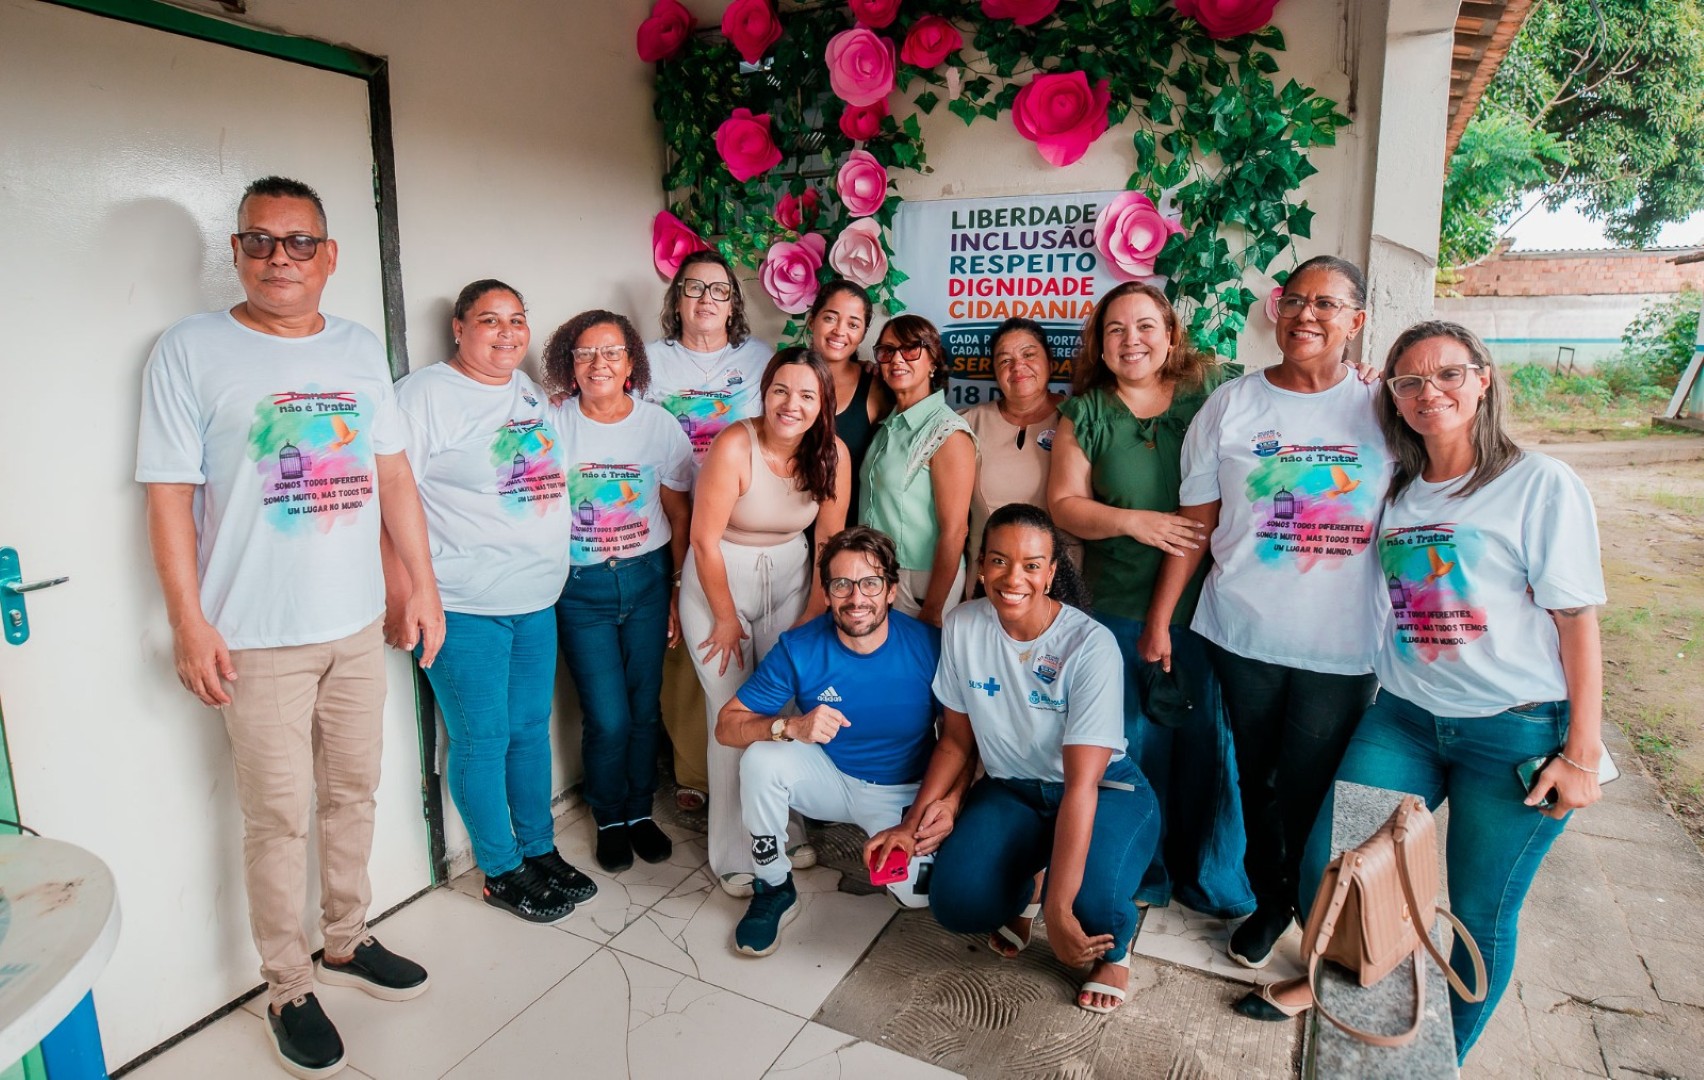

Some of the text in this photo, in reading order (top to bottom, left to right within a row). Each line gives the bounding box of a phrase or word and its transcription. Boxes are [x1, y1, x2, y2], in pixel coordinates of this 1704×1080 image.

[952, 204, 1097, 229] LIBERDADE
[951, 226, 1096, 252] INCLUSÃO
[950, 252, 1097, 274] RESPEITO
[949, 277, 1094, 297] DIGNIDADE
[949, 300, 1097, 319] CIDADANIA
[949, 334, 979, 344] CADA
[1047, 335, 1087, 346] PORTA.
[951, 346, 980, 355] CADA
[953, 357, 991, 372] SER
[952, 386, 980, 405] 18
[280, 402, 357, 413] não é Tratar
[1280, 453, 1359, 463] não é Tratar
[581, 471, 599, 479] não
[609, 471, 641, 479] Tratar
[274, 480, 301, 491] SOMOS
[303, 478, 328, 488] TODOS
[263, 495, 290, 506] SOMOS
[292, 492, 320, 502] MUITO,
[321, 490, 336, 499] MAS
[338, 488, 359, 497] TODOS
[287, 507, 300, 515] UM
[302, 505, 328, 514] LUGAR
[329, 503, 339, 511] NO
[1266, 520, 1365, 532] SOMOS TODOS DIFERENTES,
[619, 532, 636, 541] TODOS
[1256, 531, 1278, 540] SOMOS
[1280, 532, 1304, 542] MUITO,
[1306, 534, 1321, 542] MAS
[1325, 535, 1349, 544] TODOS
[1387, 532, 1454, 546] não é Tratar
[1274, 543, 1354, 556] UM LUGAR NO MUNDO.
[1427, 610, 1473, 619] DFERENTES,
[1435, 624, 1458, 632] TODOS
[1459, 623, 1489, 632] TEMOS
